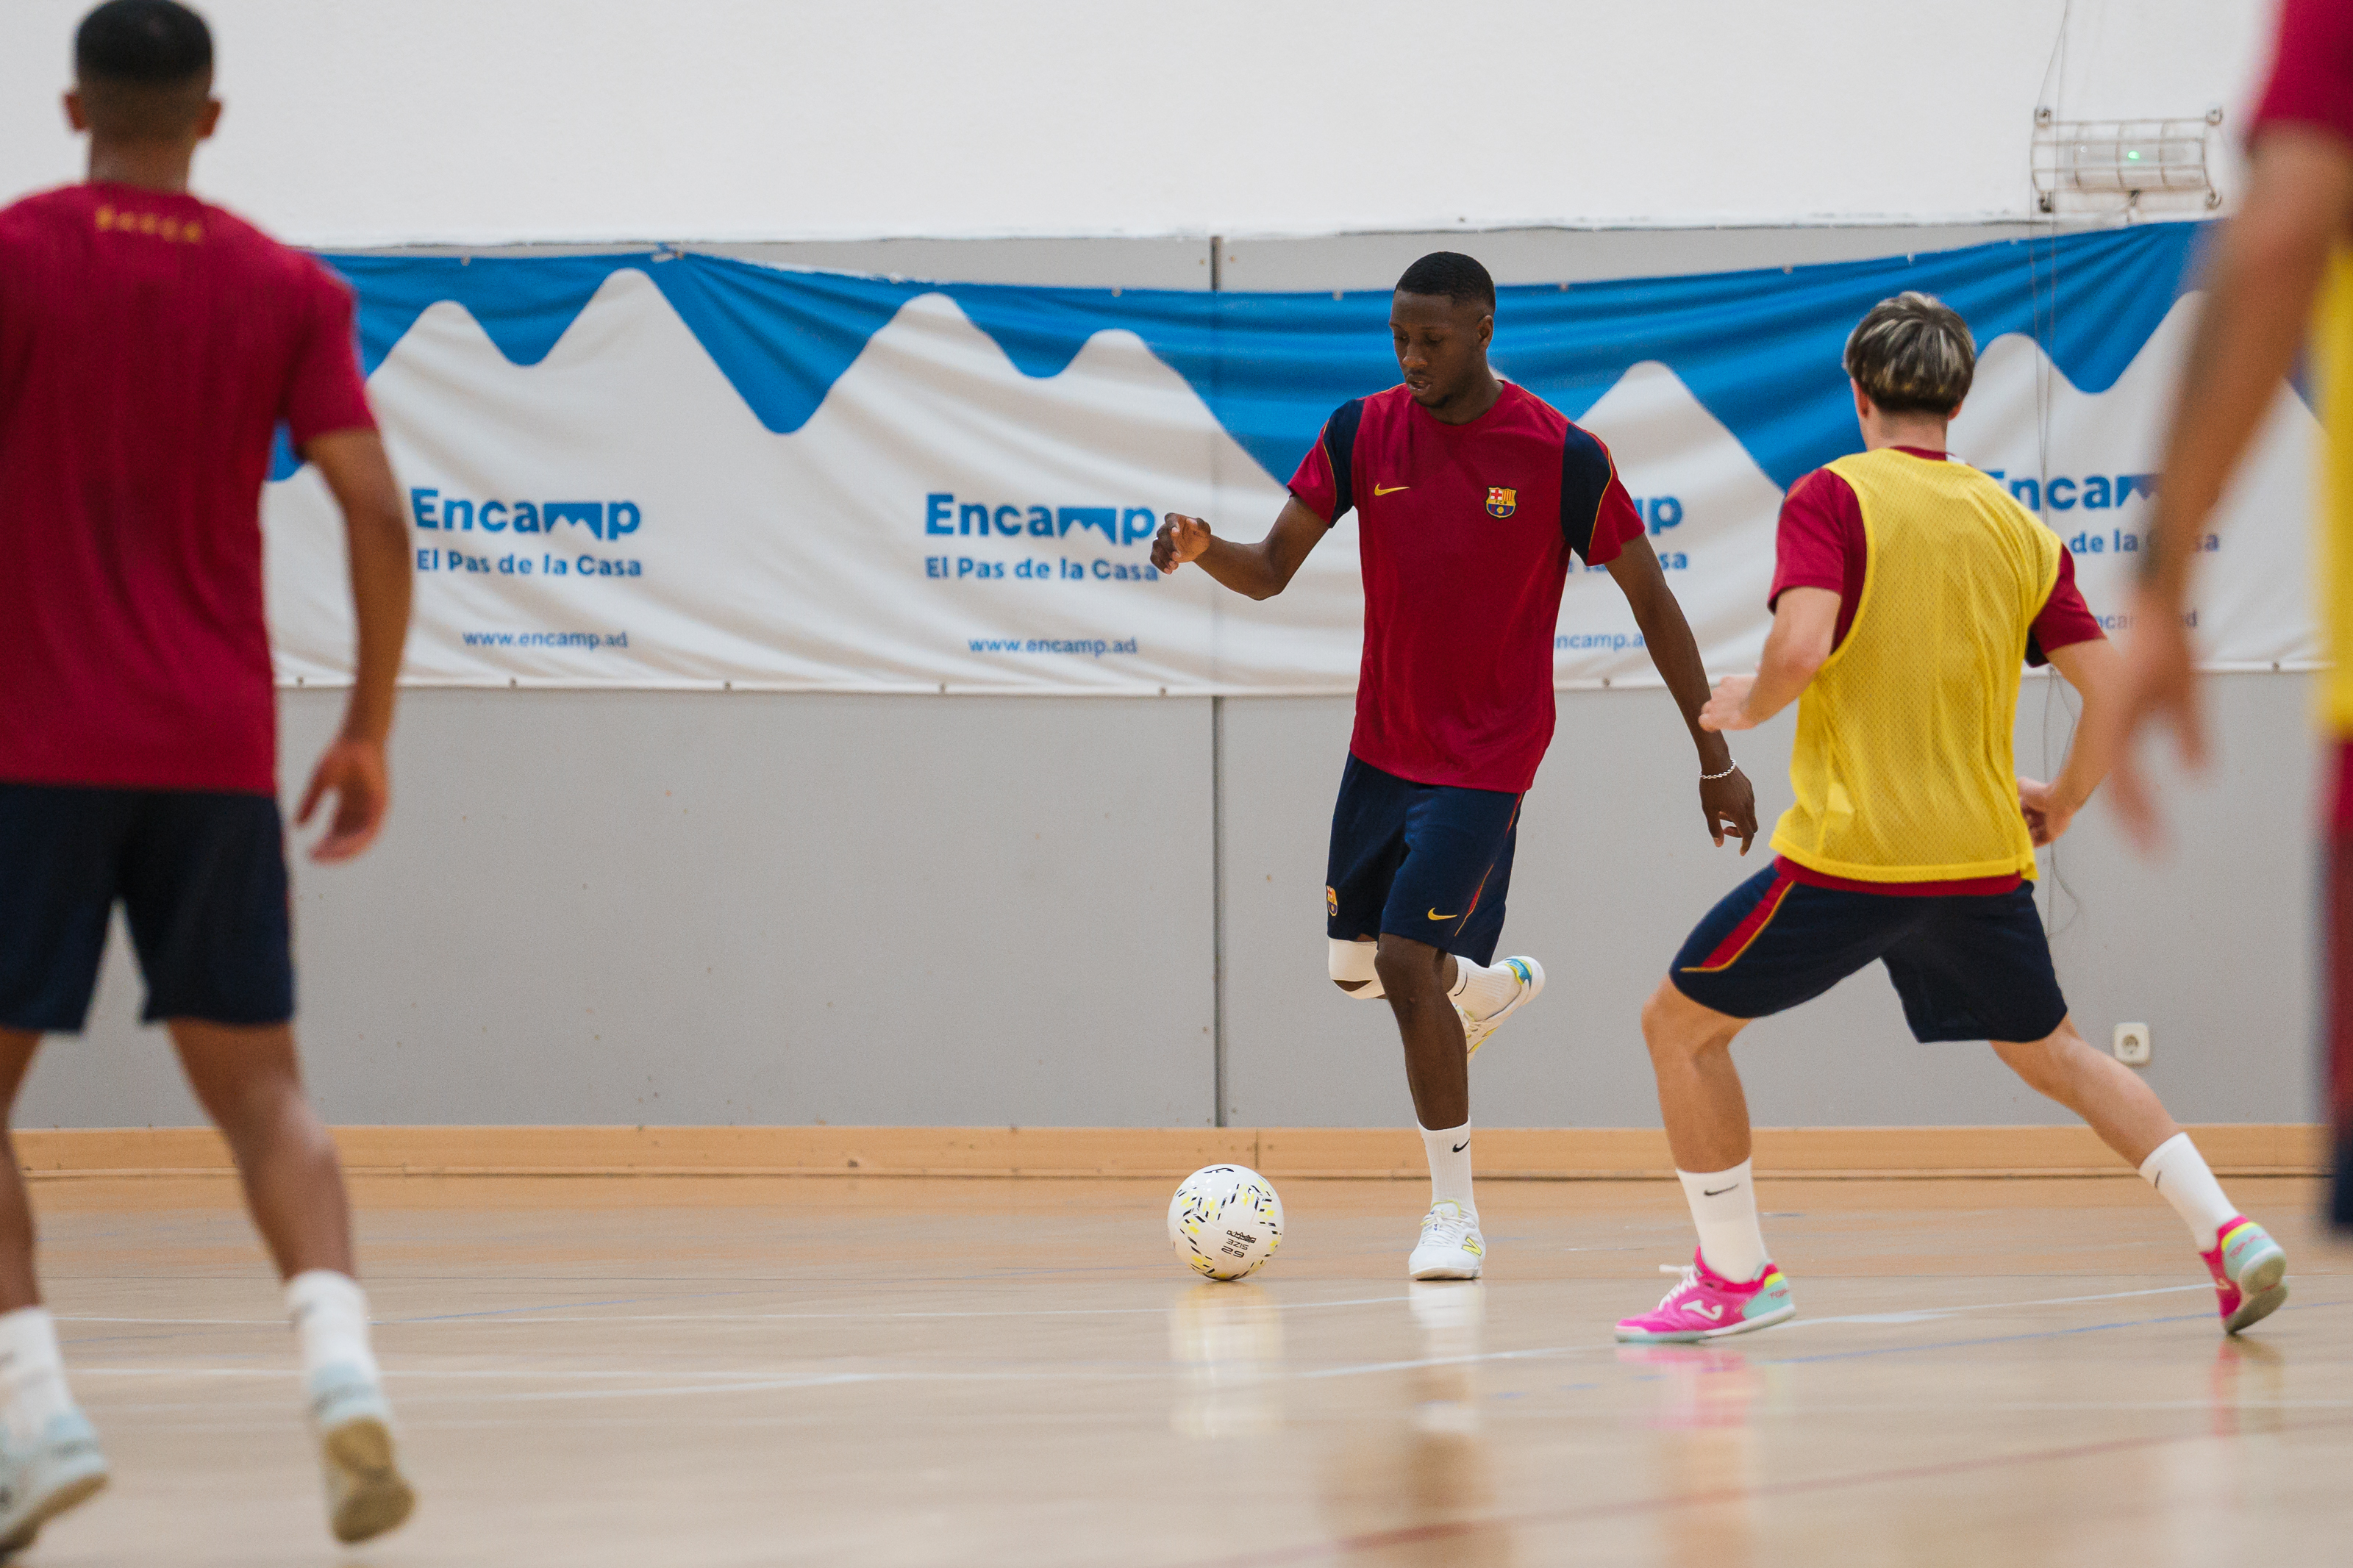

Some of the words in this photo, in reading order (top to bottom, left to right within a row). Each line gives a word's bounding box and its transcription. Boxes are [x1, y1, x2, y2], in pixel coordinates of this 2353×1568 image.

[410, 486, 642, 542] Encamp
[924, 492, 1156, 546] Encamp
[2069, 531, 2104, 554] de
[2113, 529, 2138, 553] la
[417, 548, 439, 571] El
[447, 551, 490, 573] Pas
[498, 553, 533, 576] de
[543, 554, 568, 576] la
[575, 554, 643, 577] Casa
[925, 556, 949, 579] El
[957, 557, 1005, 580] Pas
[1013, 556, 1051, 580] de
[1060, 557, 1085, 581] la
[1091, 559, 1159, 581] Casa
[463, 631, 627, 651] www.encamp.ad
[968, 636, 1138, 658] www.encamp.ad
[1221, 1245, 1245, 1258] 62
[1226, 1238, 1249, 1250] SIZE
